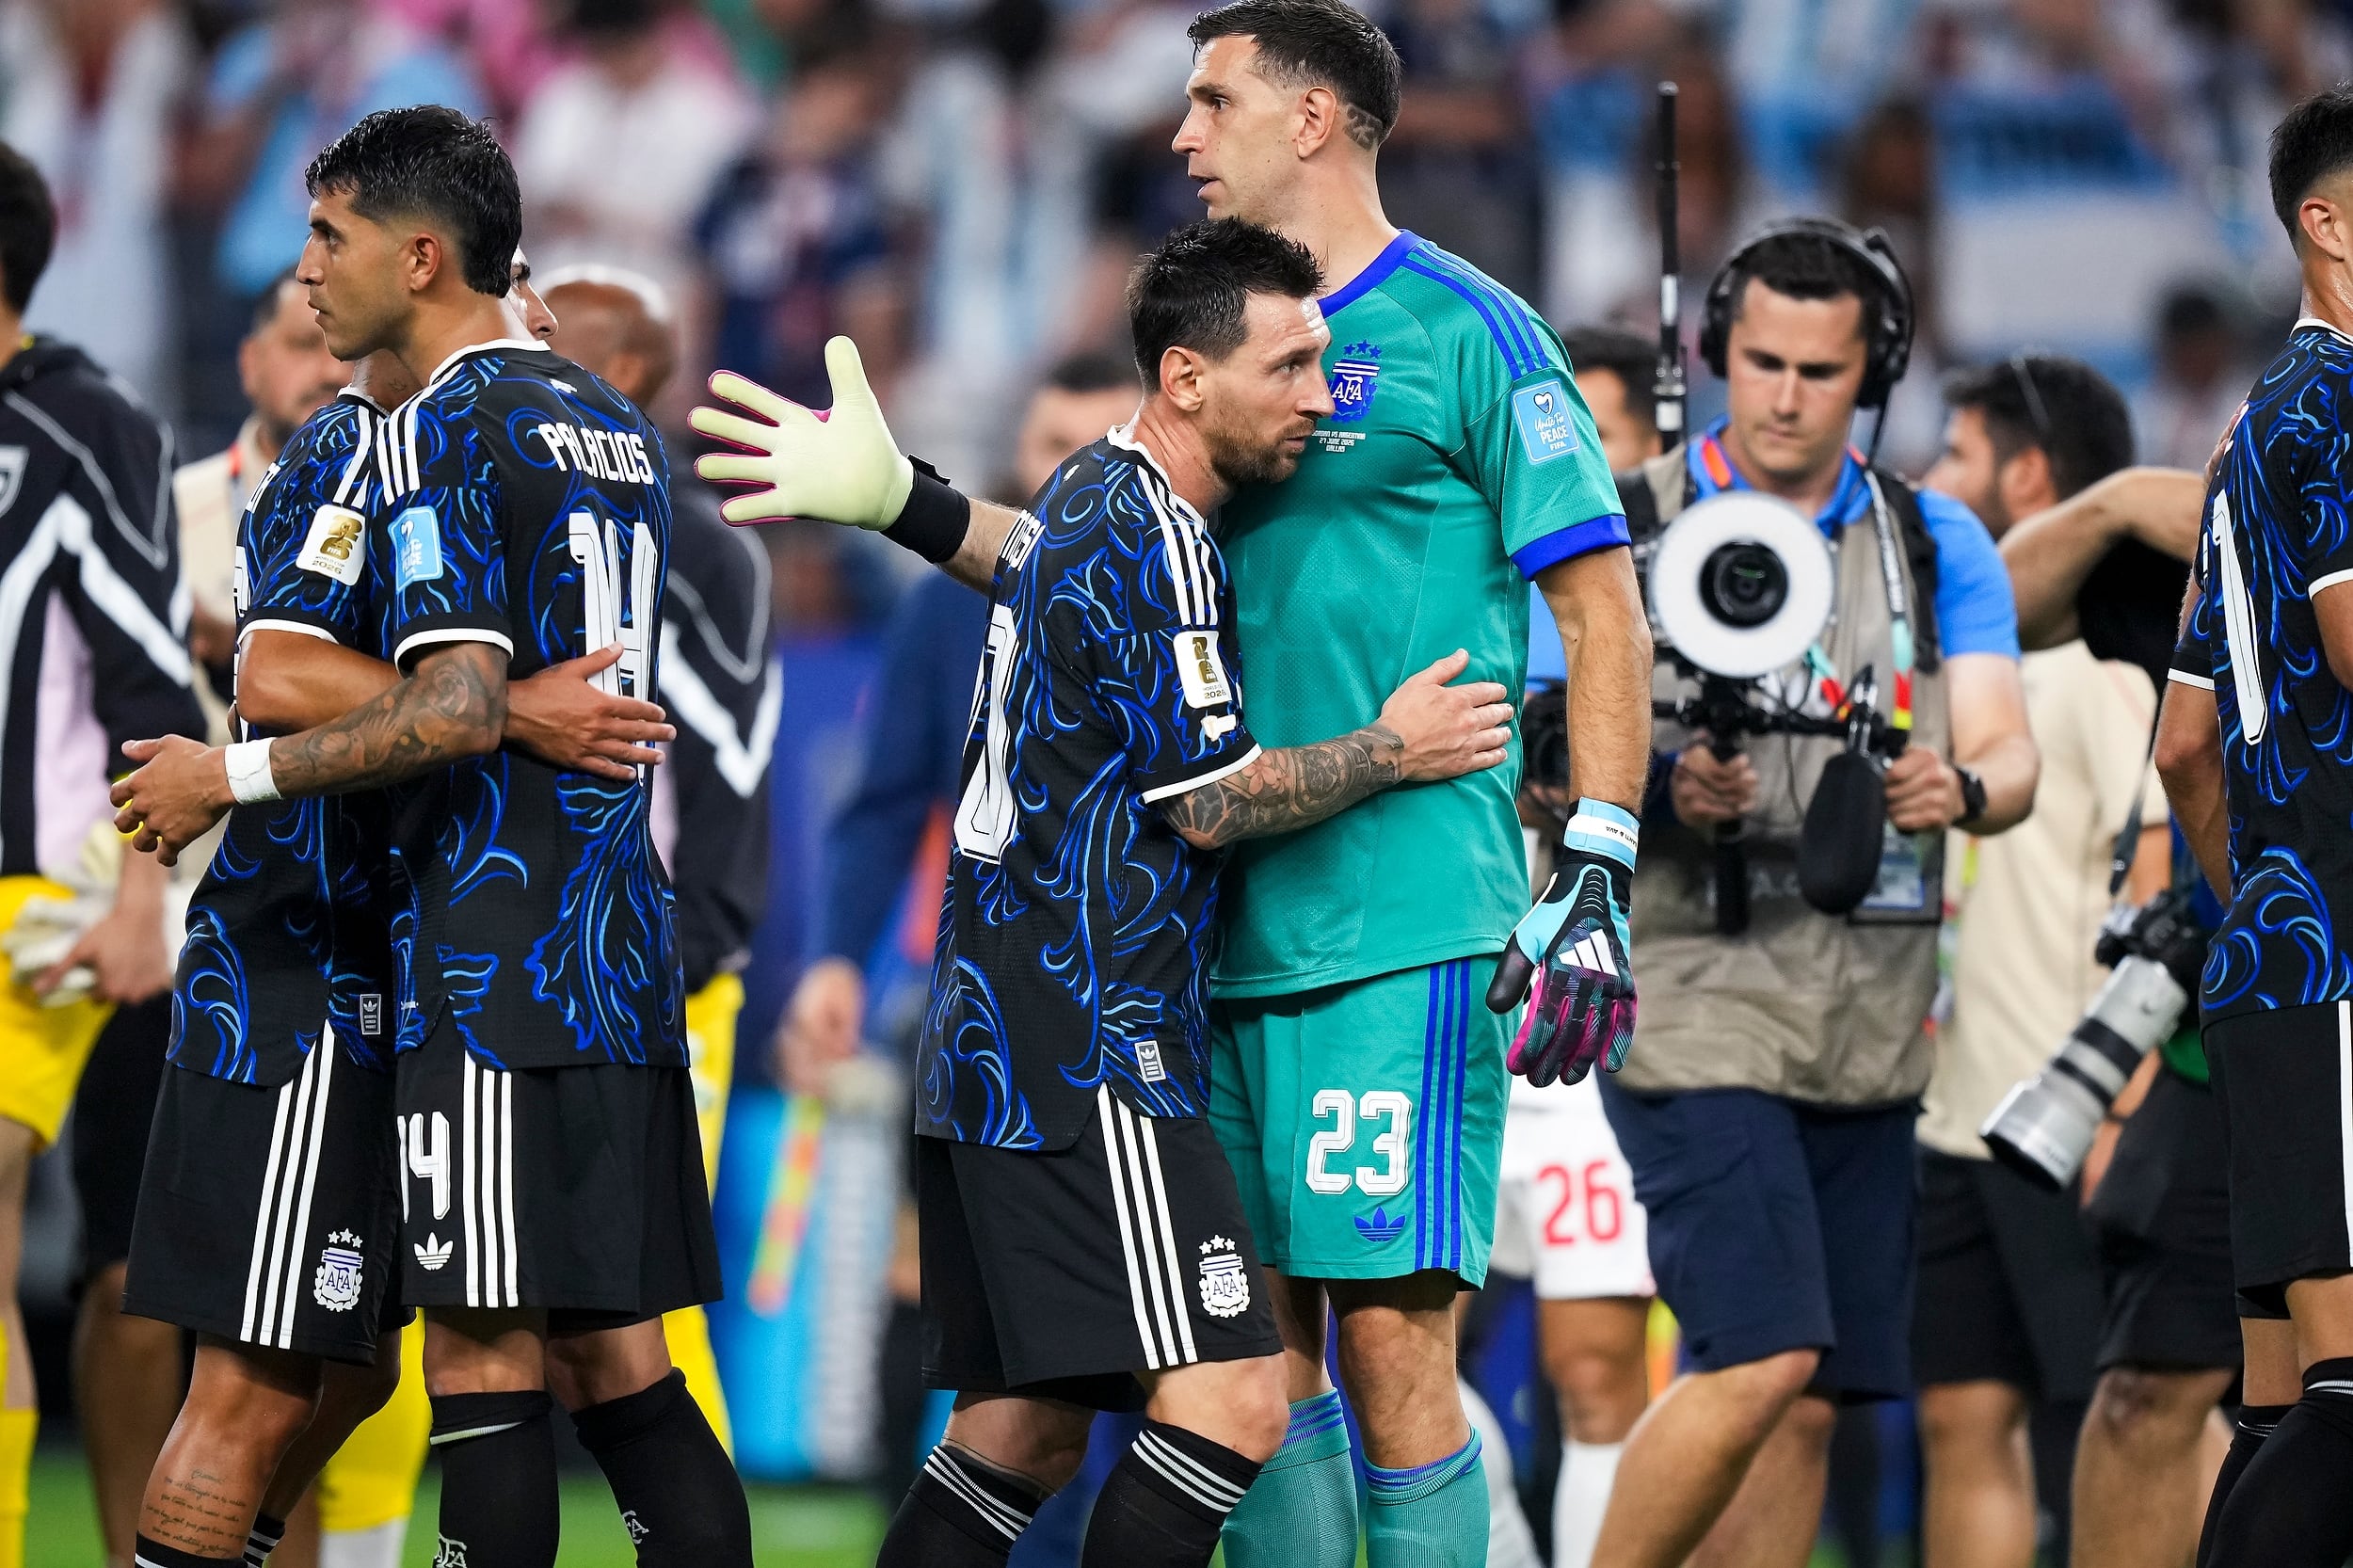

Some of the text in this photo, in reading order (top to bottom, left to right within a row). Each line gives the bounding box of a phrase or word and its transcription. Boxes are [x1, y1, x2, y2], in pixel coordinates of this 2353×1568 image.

[1331, 374, 1364, 406] AFA
[537, 422, 654, 486] PALACIOS
[1540, 424, 1569, 445] PEACE
[568, 512, 658, 787] 14
[952, 602, 1019, 865] 0
[1305, 1089, 1413, 1196] 23
[1536, 1160, 1623, 1246] 26
[326, 1265, 352, 1294] AFA
[1212, 1271, 1240, 1298] AFA
